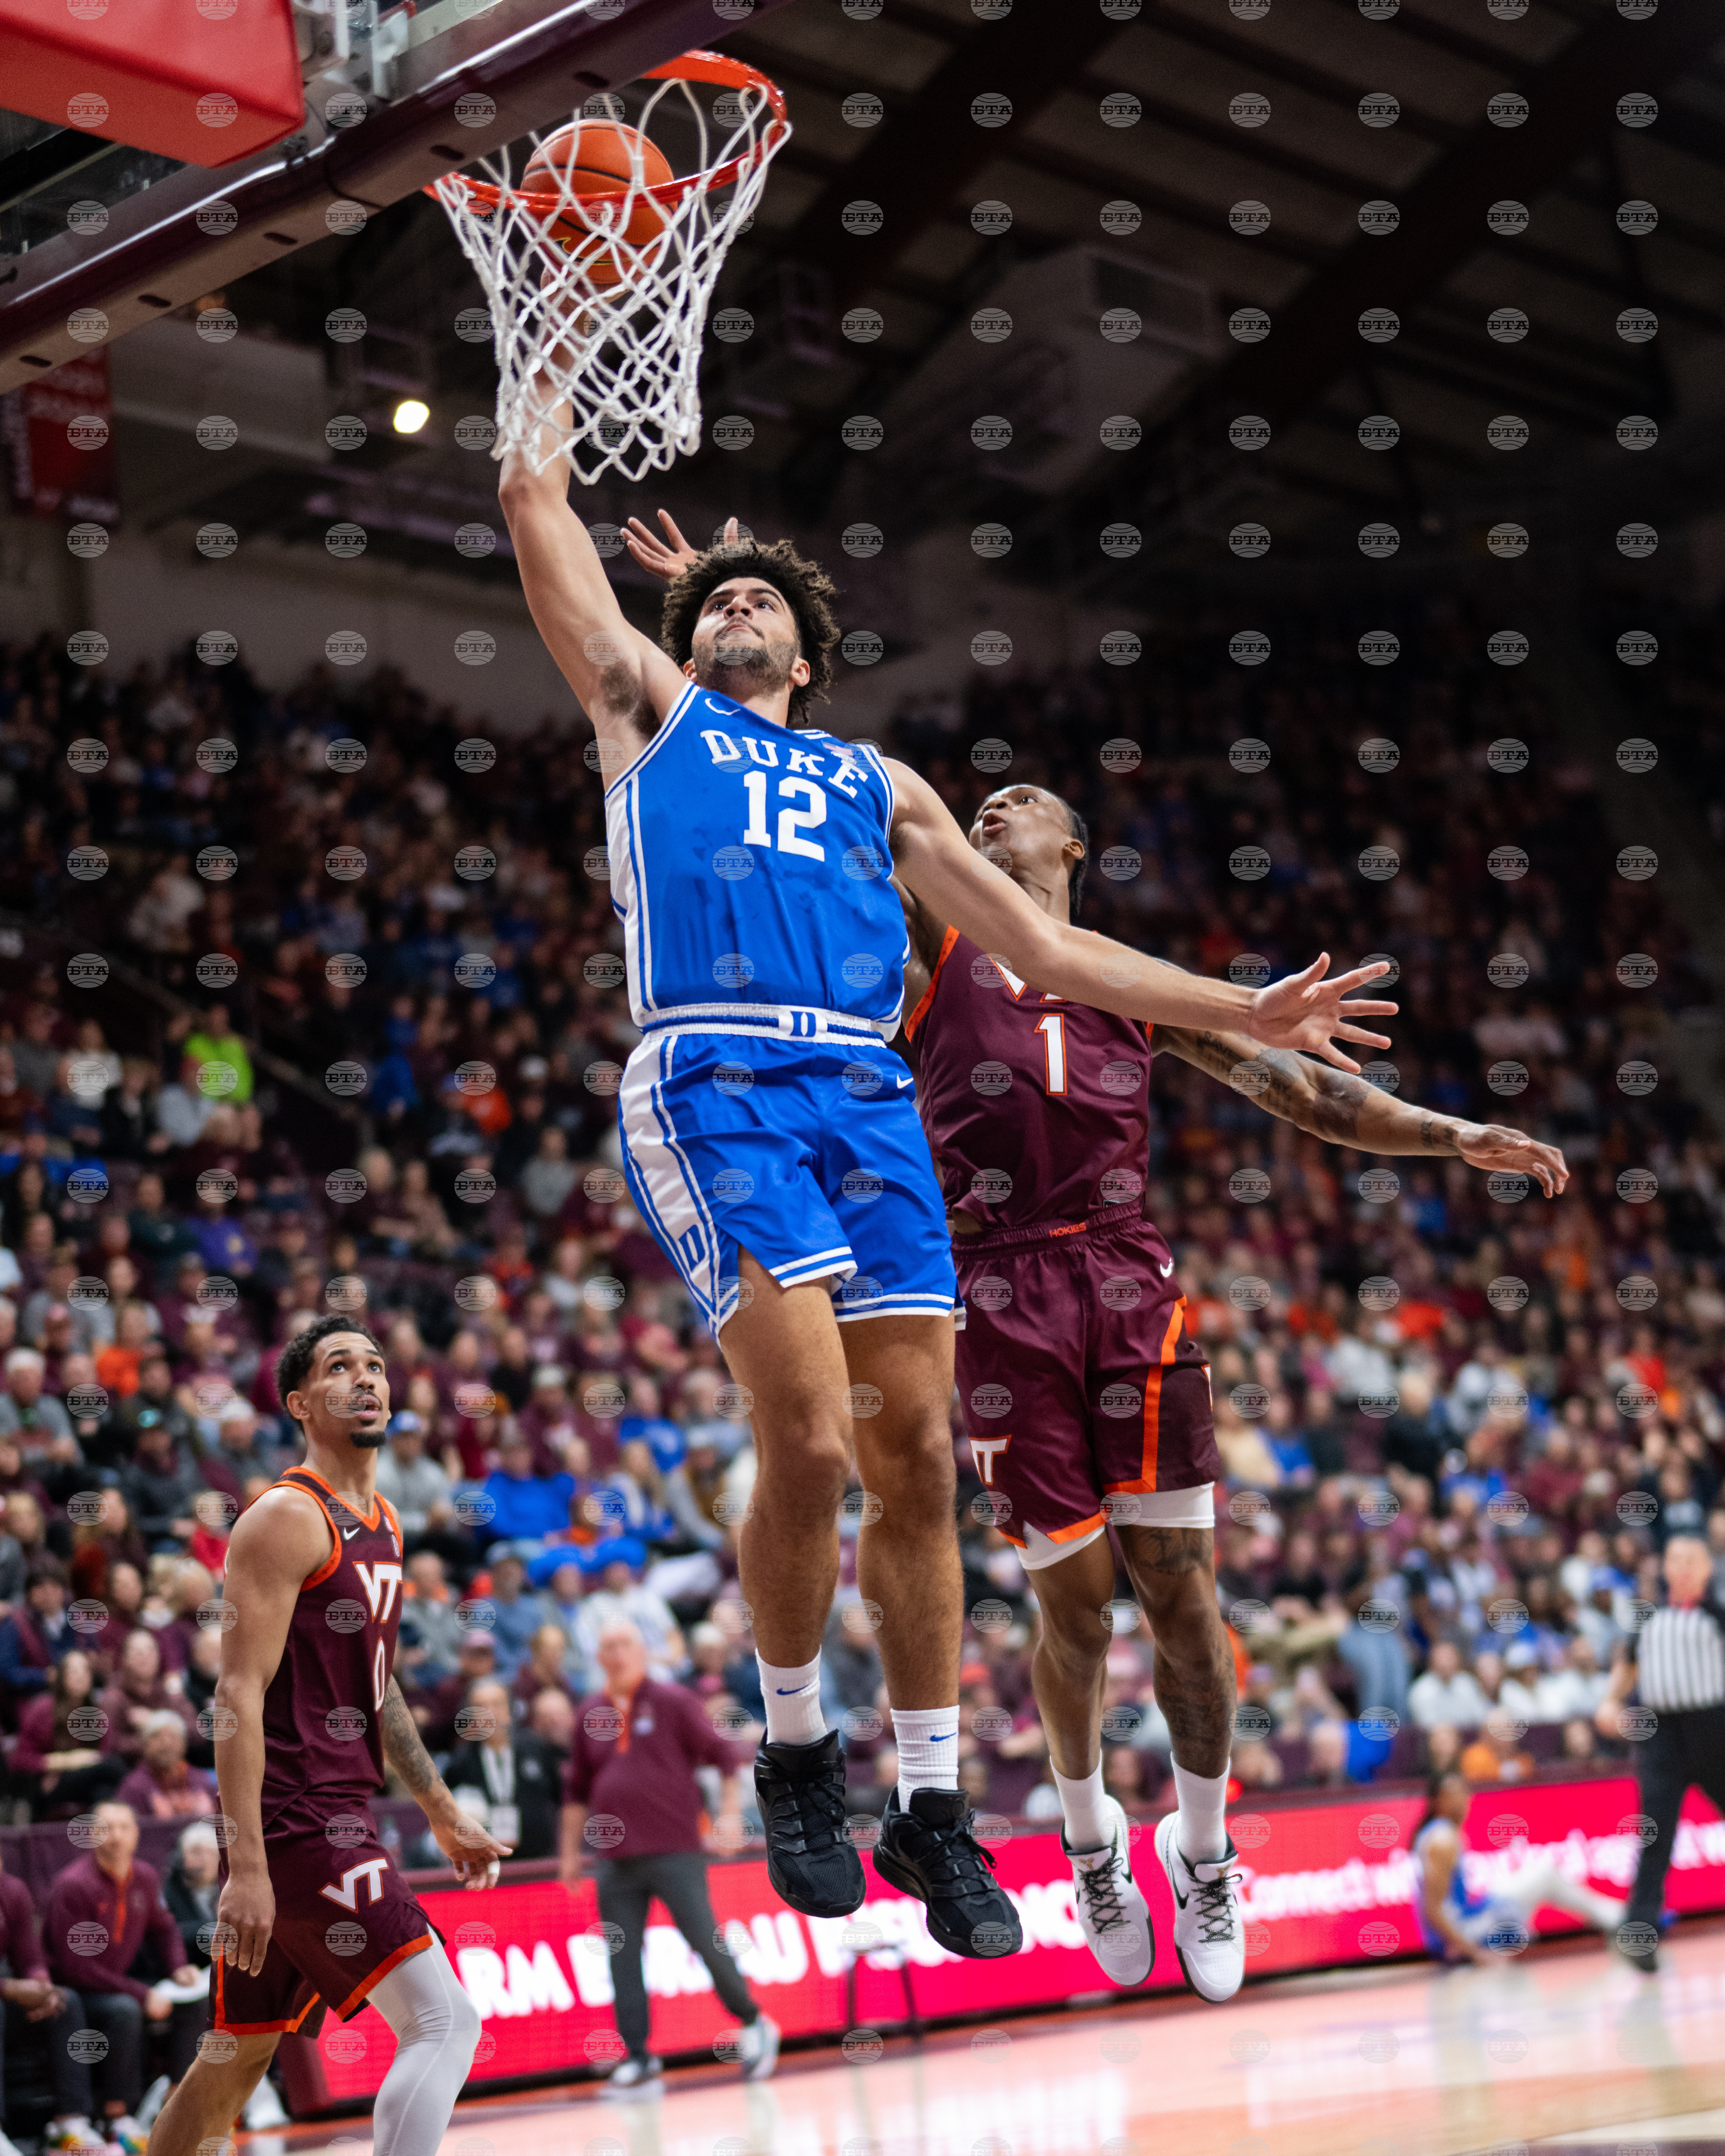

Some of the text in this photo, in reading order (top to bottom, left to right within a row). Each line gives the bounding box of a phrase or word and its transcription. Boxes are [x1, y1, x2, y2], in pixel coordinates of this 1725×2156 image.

[700, 730, 870, 799] DUKE
[743, 771, 827, 862] 12
[1034, 1013, 1067, 1095] 1
[1049, 1222, 1086, 1238] HOKIES
[353, 1561, 402, 1623] VT
[374, 1637, 385, 1712] 0
[318, 1857, 389, 1913] VT
